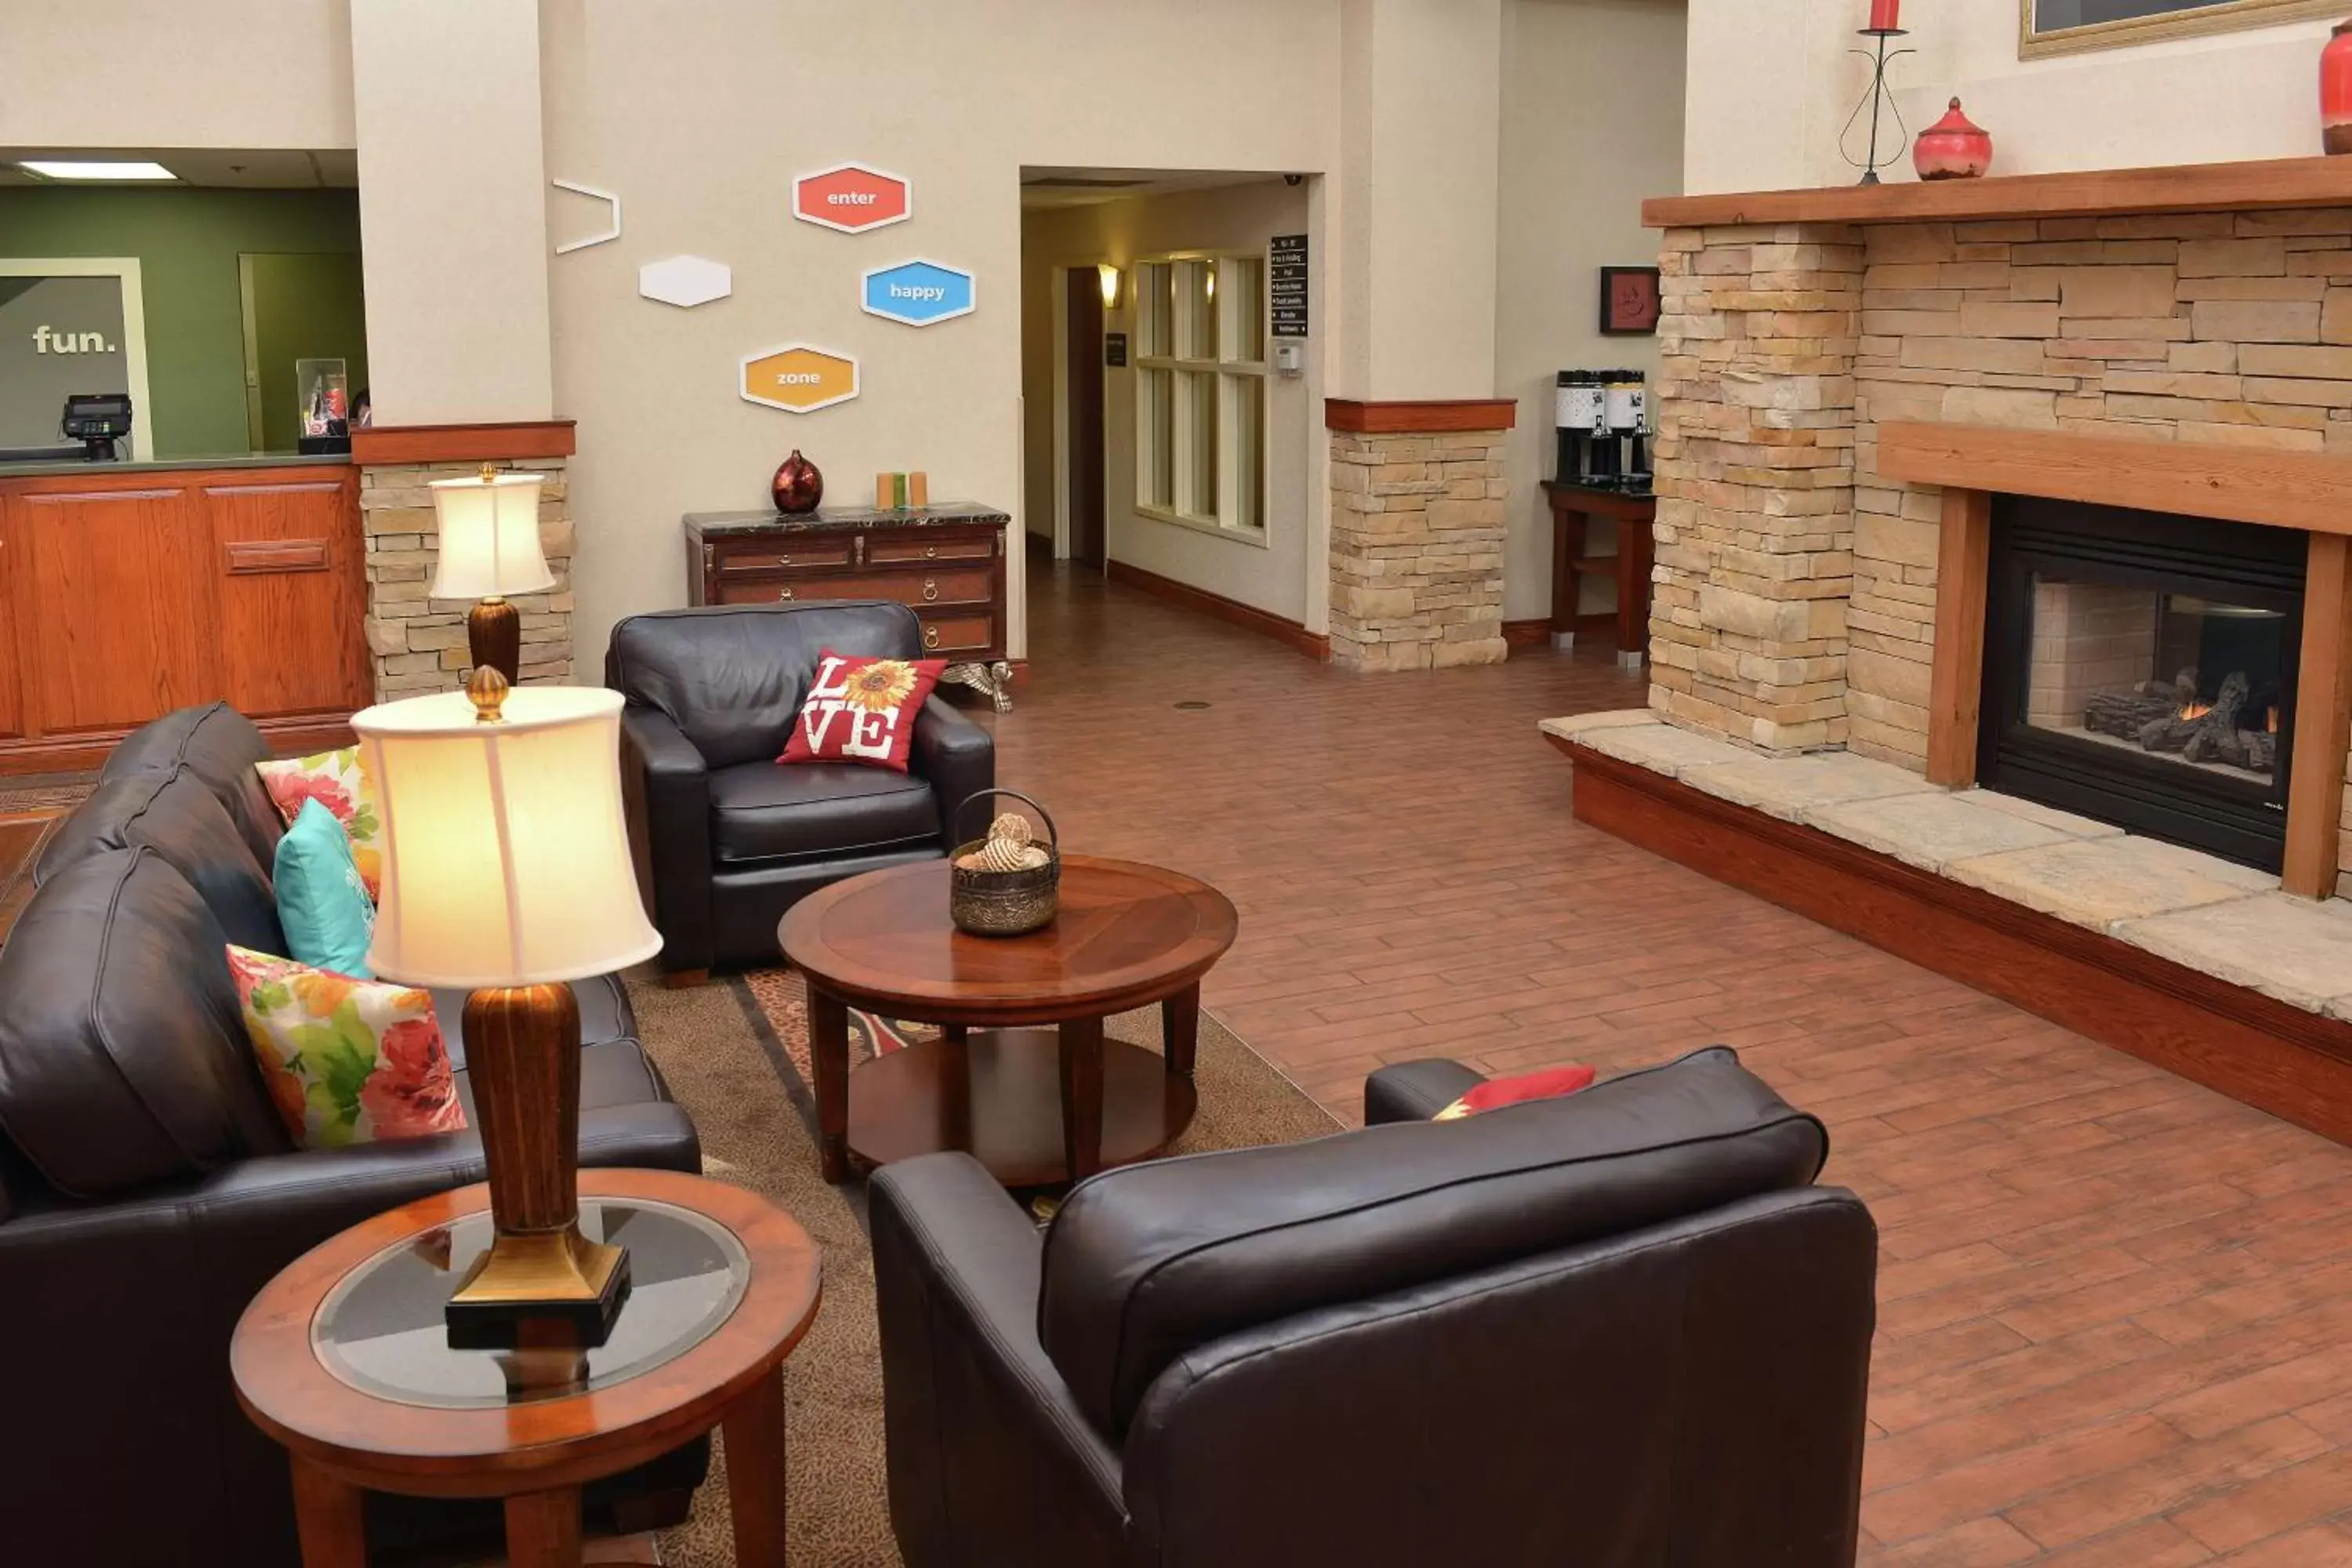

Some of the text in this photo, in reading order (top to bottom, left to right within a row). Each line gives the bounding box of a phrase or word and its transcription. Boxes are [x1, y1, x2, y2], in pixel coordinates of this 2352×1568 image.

[827, 190, 877, 205] enter
[890, 282, 945, 302] happy
[32, 325, 115, 354] fun.
[776, 371, 821, 385] zone
